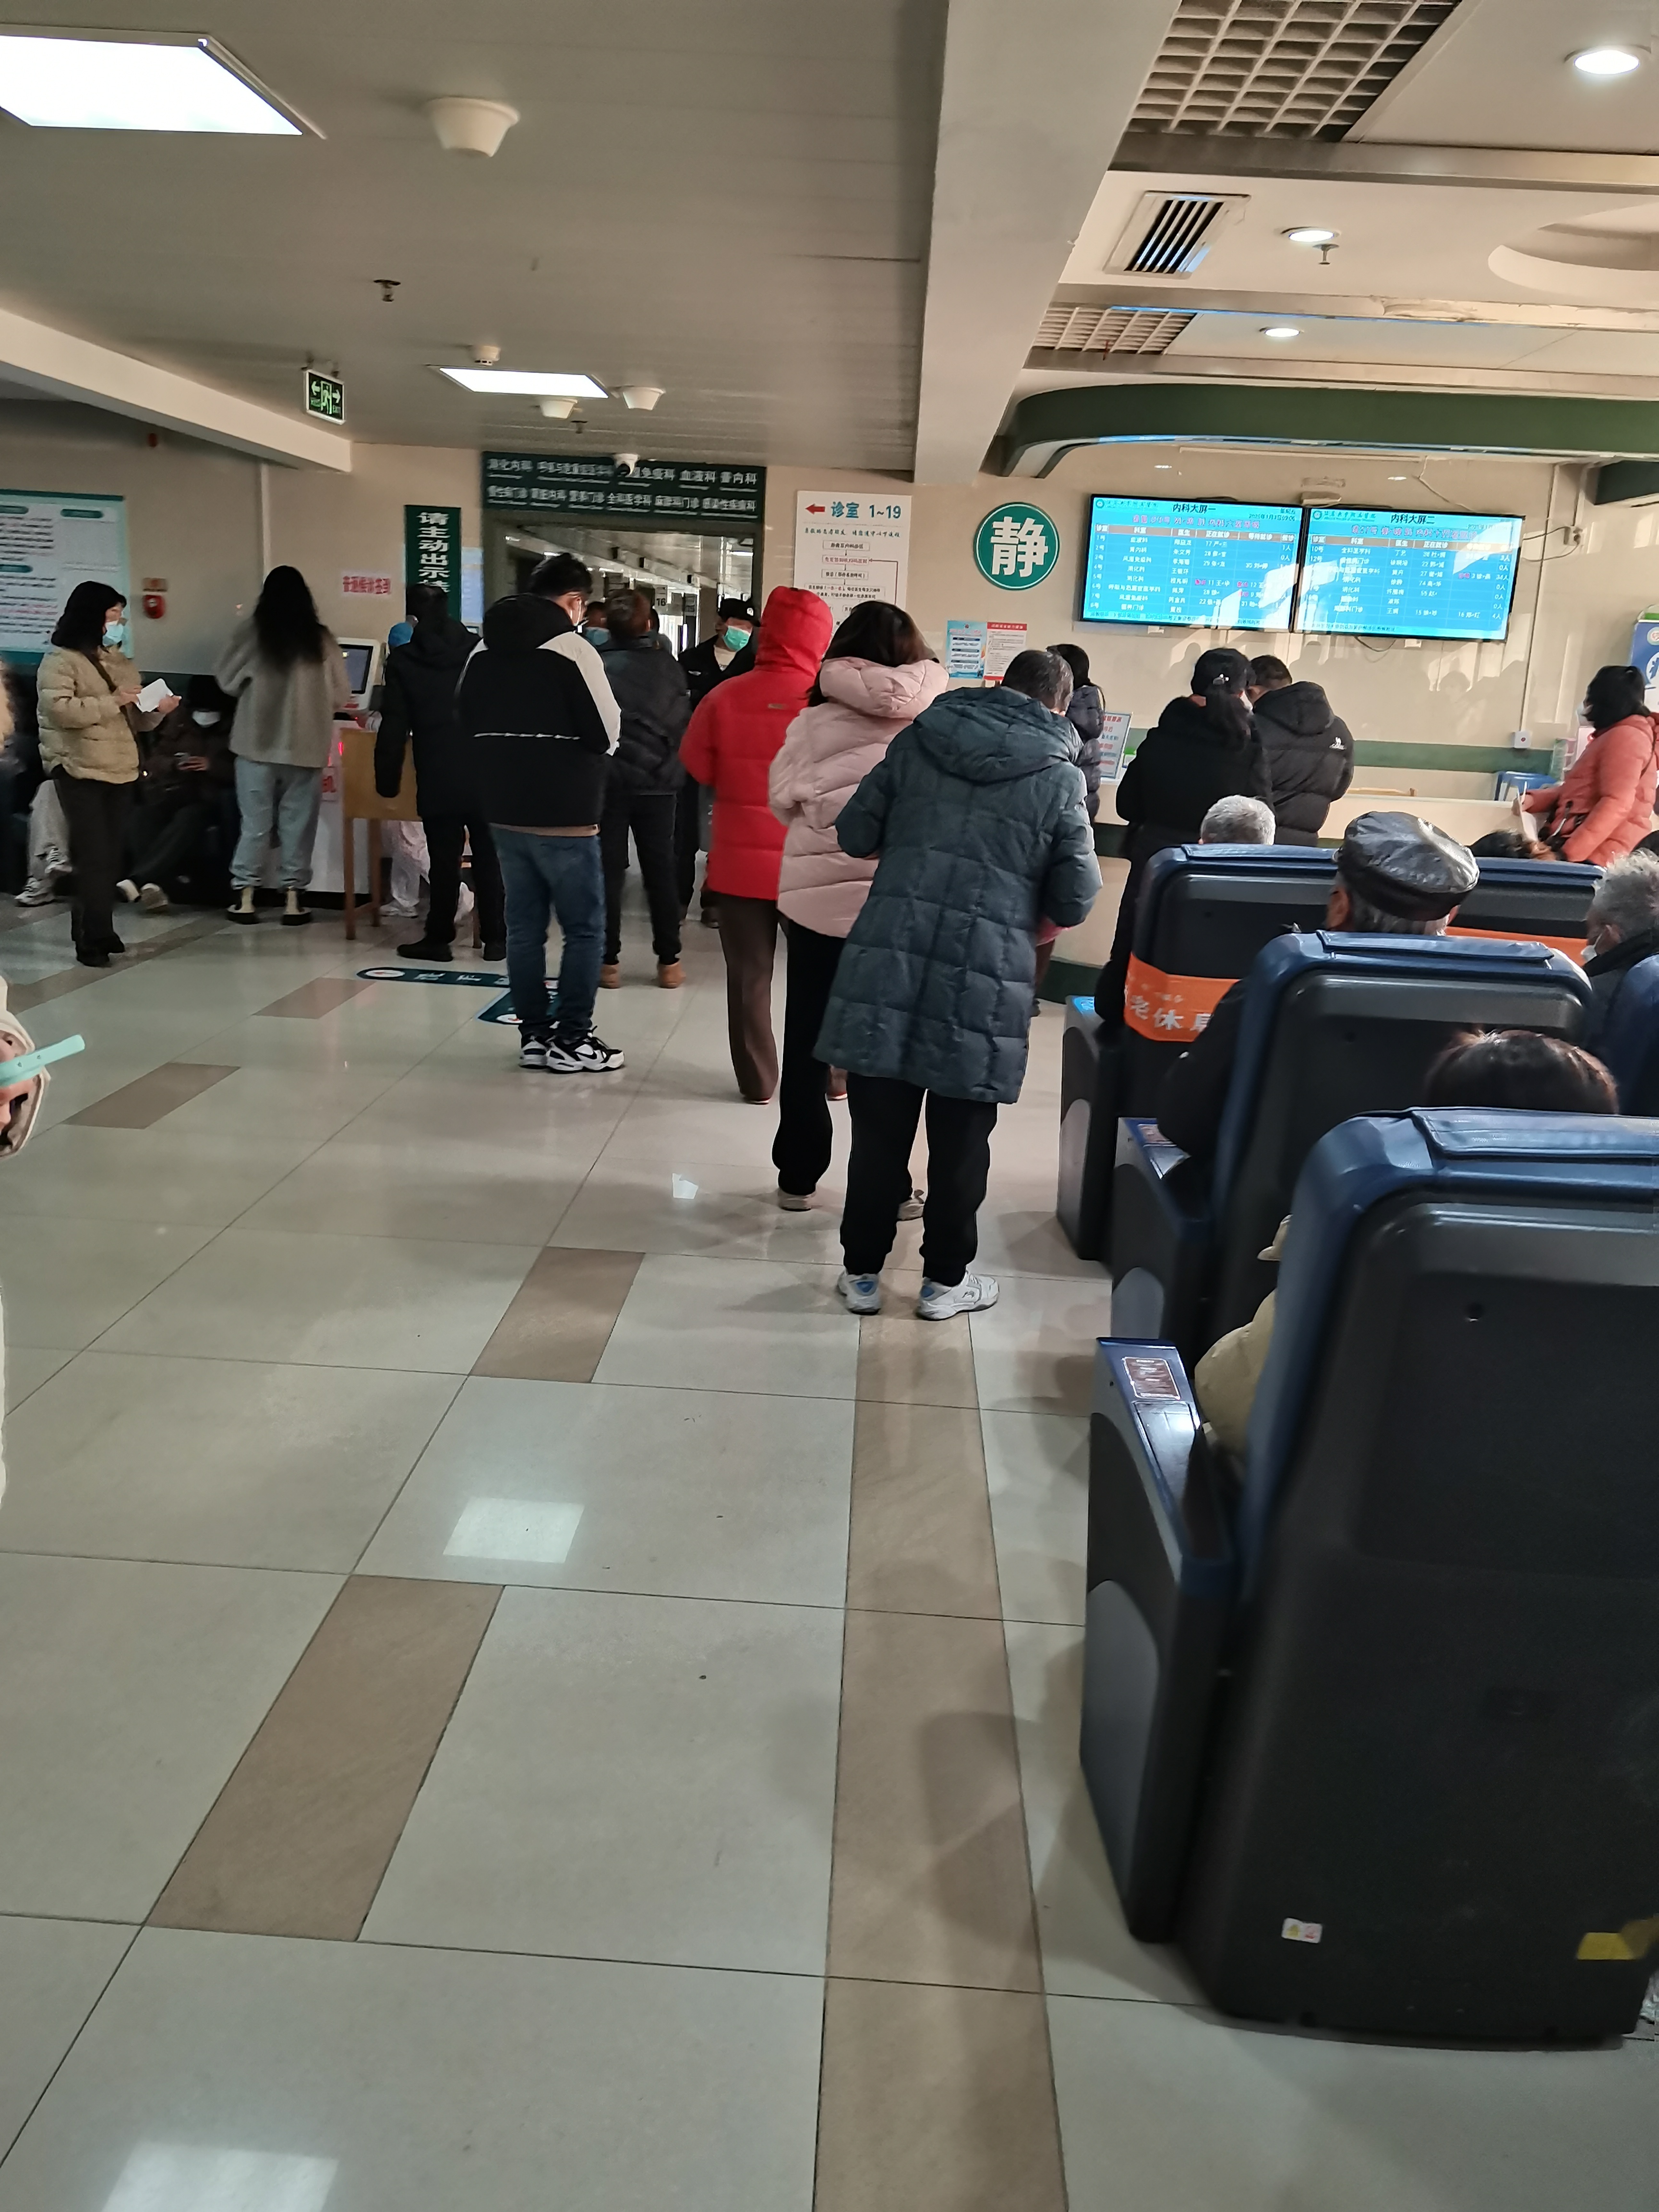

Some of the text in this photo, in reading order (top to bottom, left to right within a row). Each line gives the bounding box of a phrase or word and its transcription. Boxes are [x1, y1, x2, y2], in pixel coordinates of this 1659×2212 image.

[830, 501, 901, 519] 诊室 1~19
[1172, 503, 1216, 514] 内科大屏一
[1390, 513, 1435, 525] 内科大屏二
[990, 516, 1048, 577] 静
